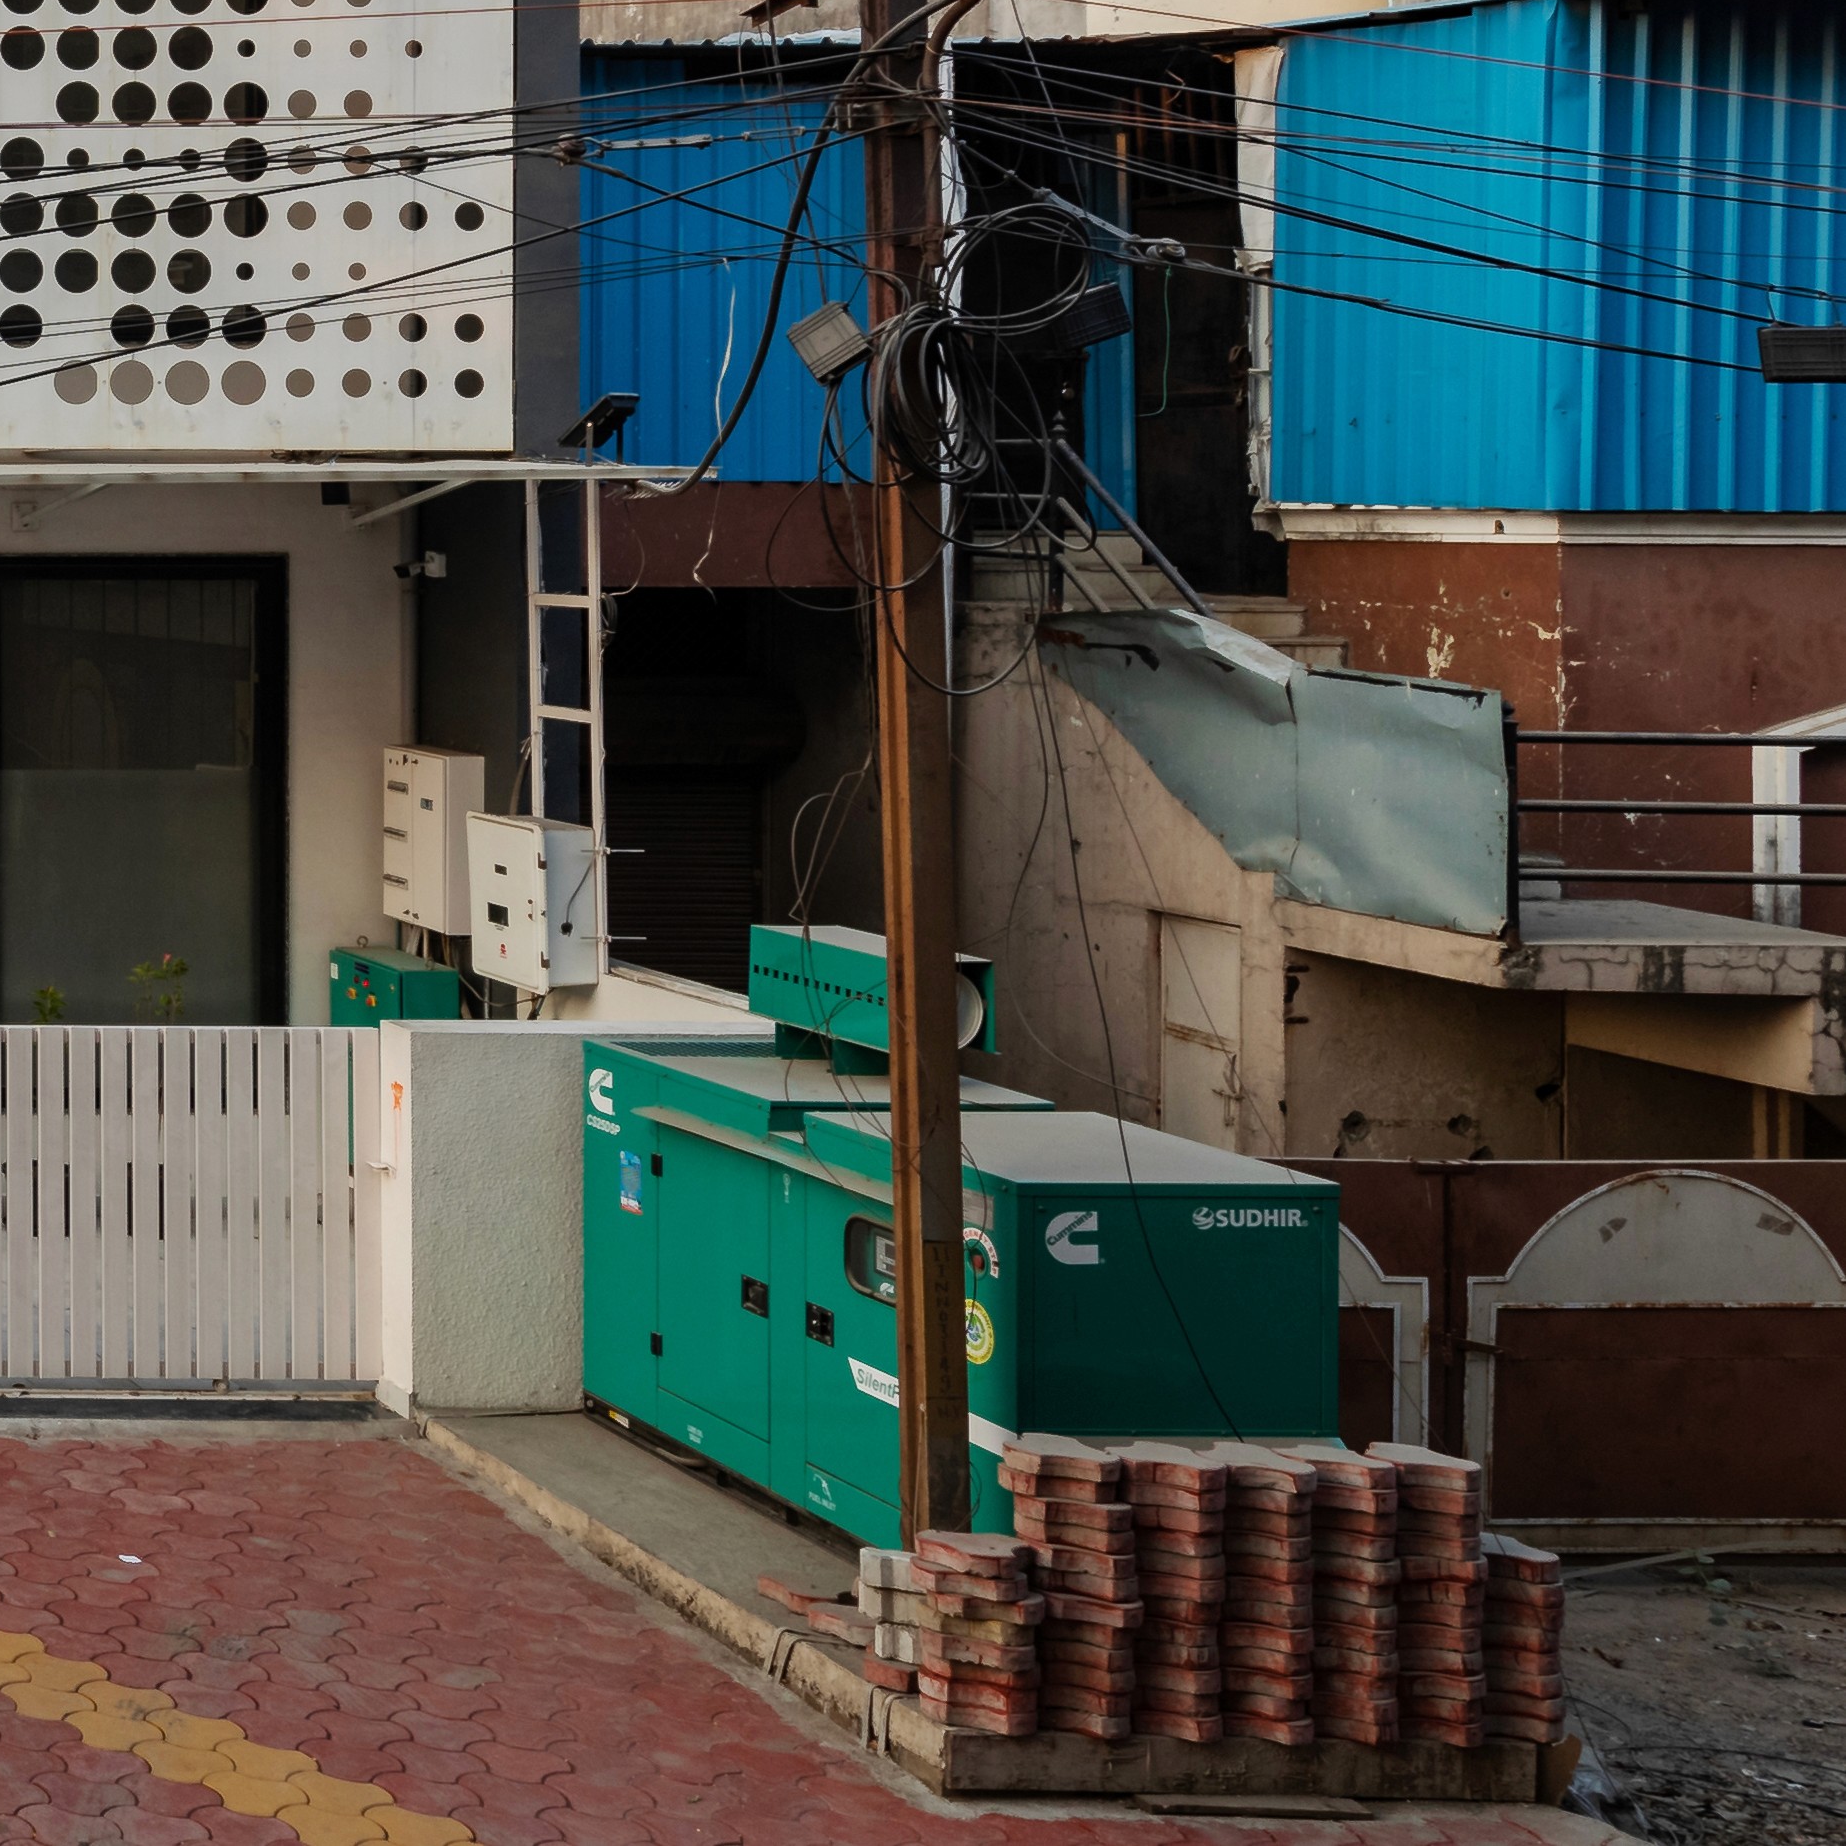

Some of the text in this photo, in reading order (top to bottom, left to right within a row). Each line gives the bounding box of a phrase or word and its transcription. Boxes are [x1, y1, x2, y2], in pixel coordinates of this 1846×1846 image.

[1046, 1211, 1093, 1246] Cummins
[1216, 1209, 1302, 1227] SUDHIR
[857, 1368, 900, 1400] SilentP
